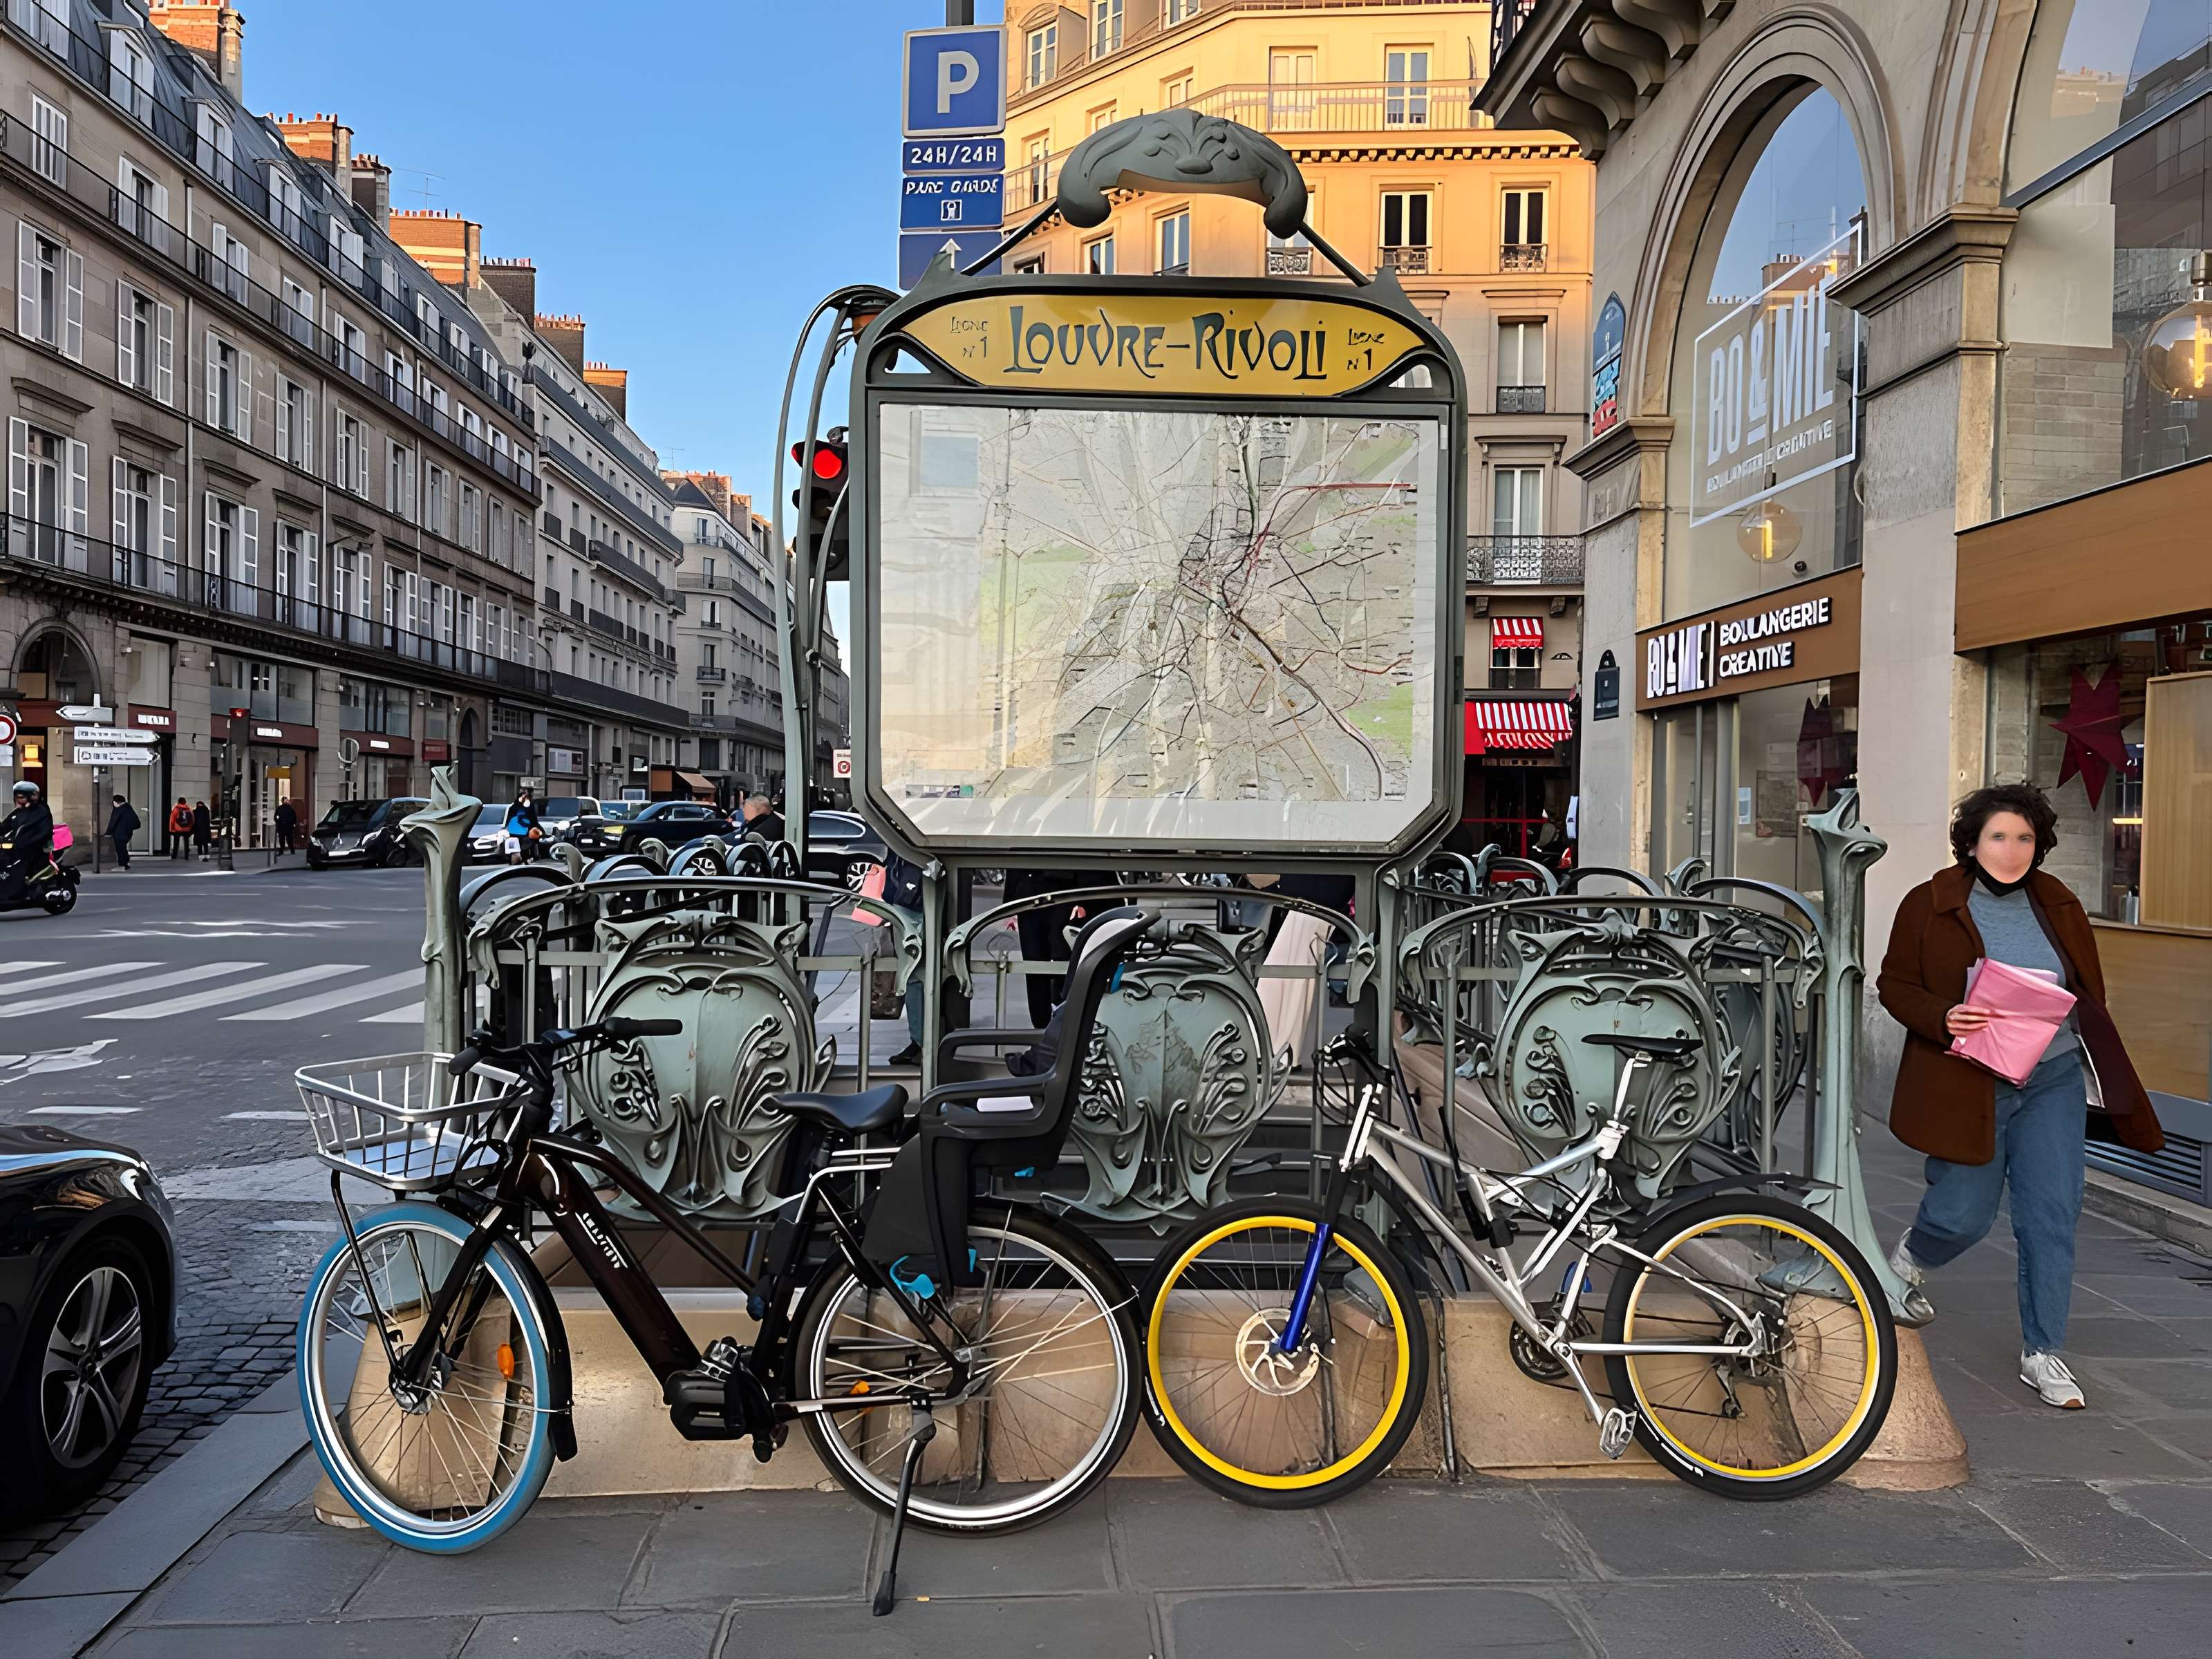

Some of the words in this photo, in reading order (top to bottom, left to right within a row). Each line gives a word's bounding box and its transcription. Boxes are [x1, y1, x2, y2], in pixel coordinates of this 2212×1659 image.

[937, 50, 980, 113] P
[911, 144, 997, 165] 24H/24H
[1720, 597, 1829, 646] BOULANGERIE
